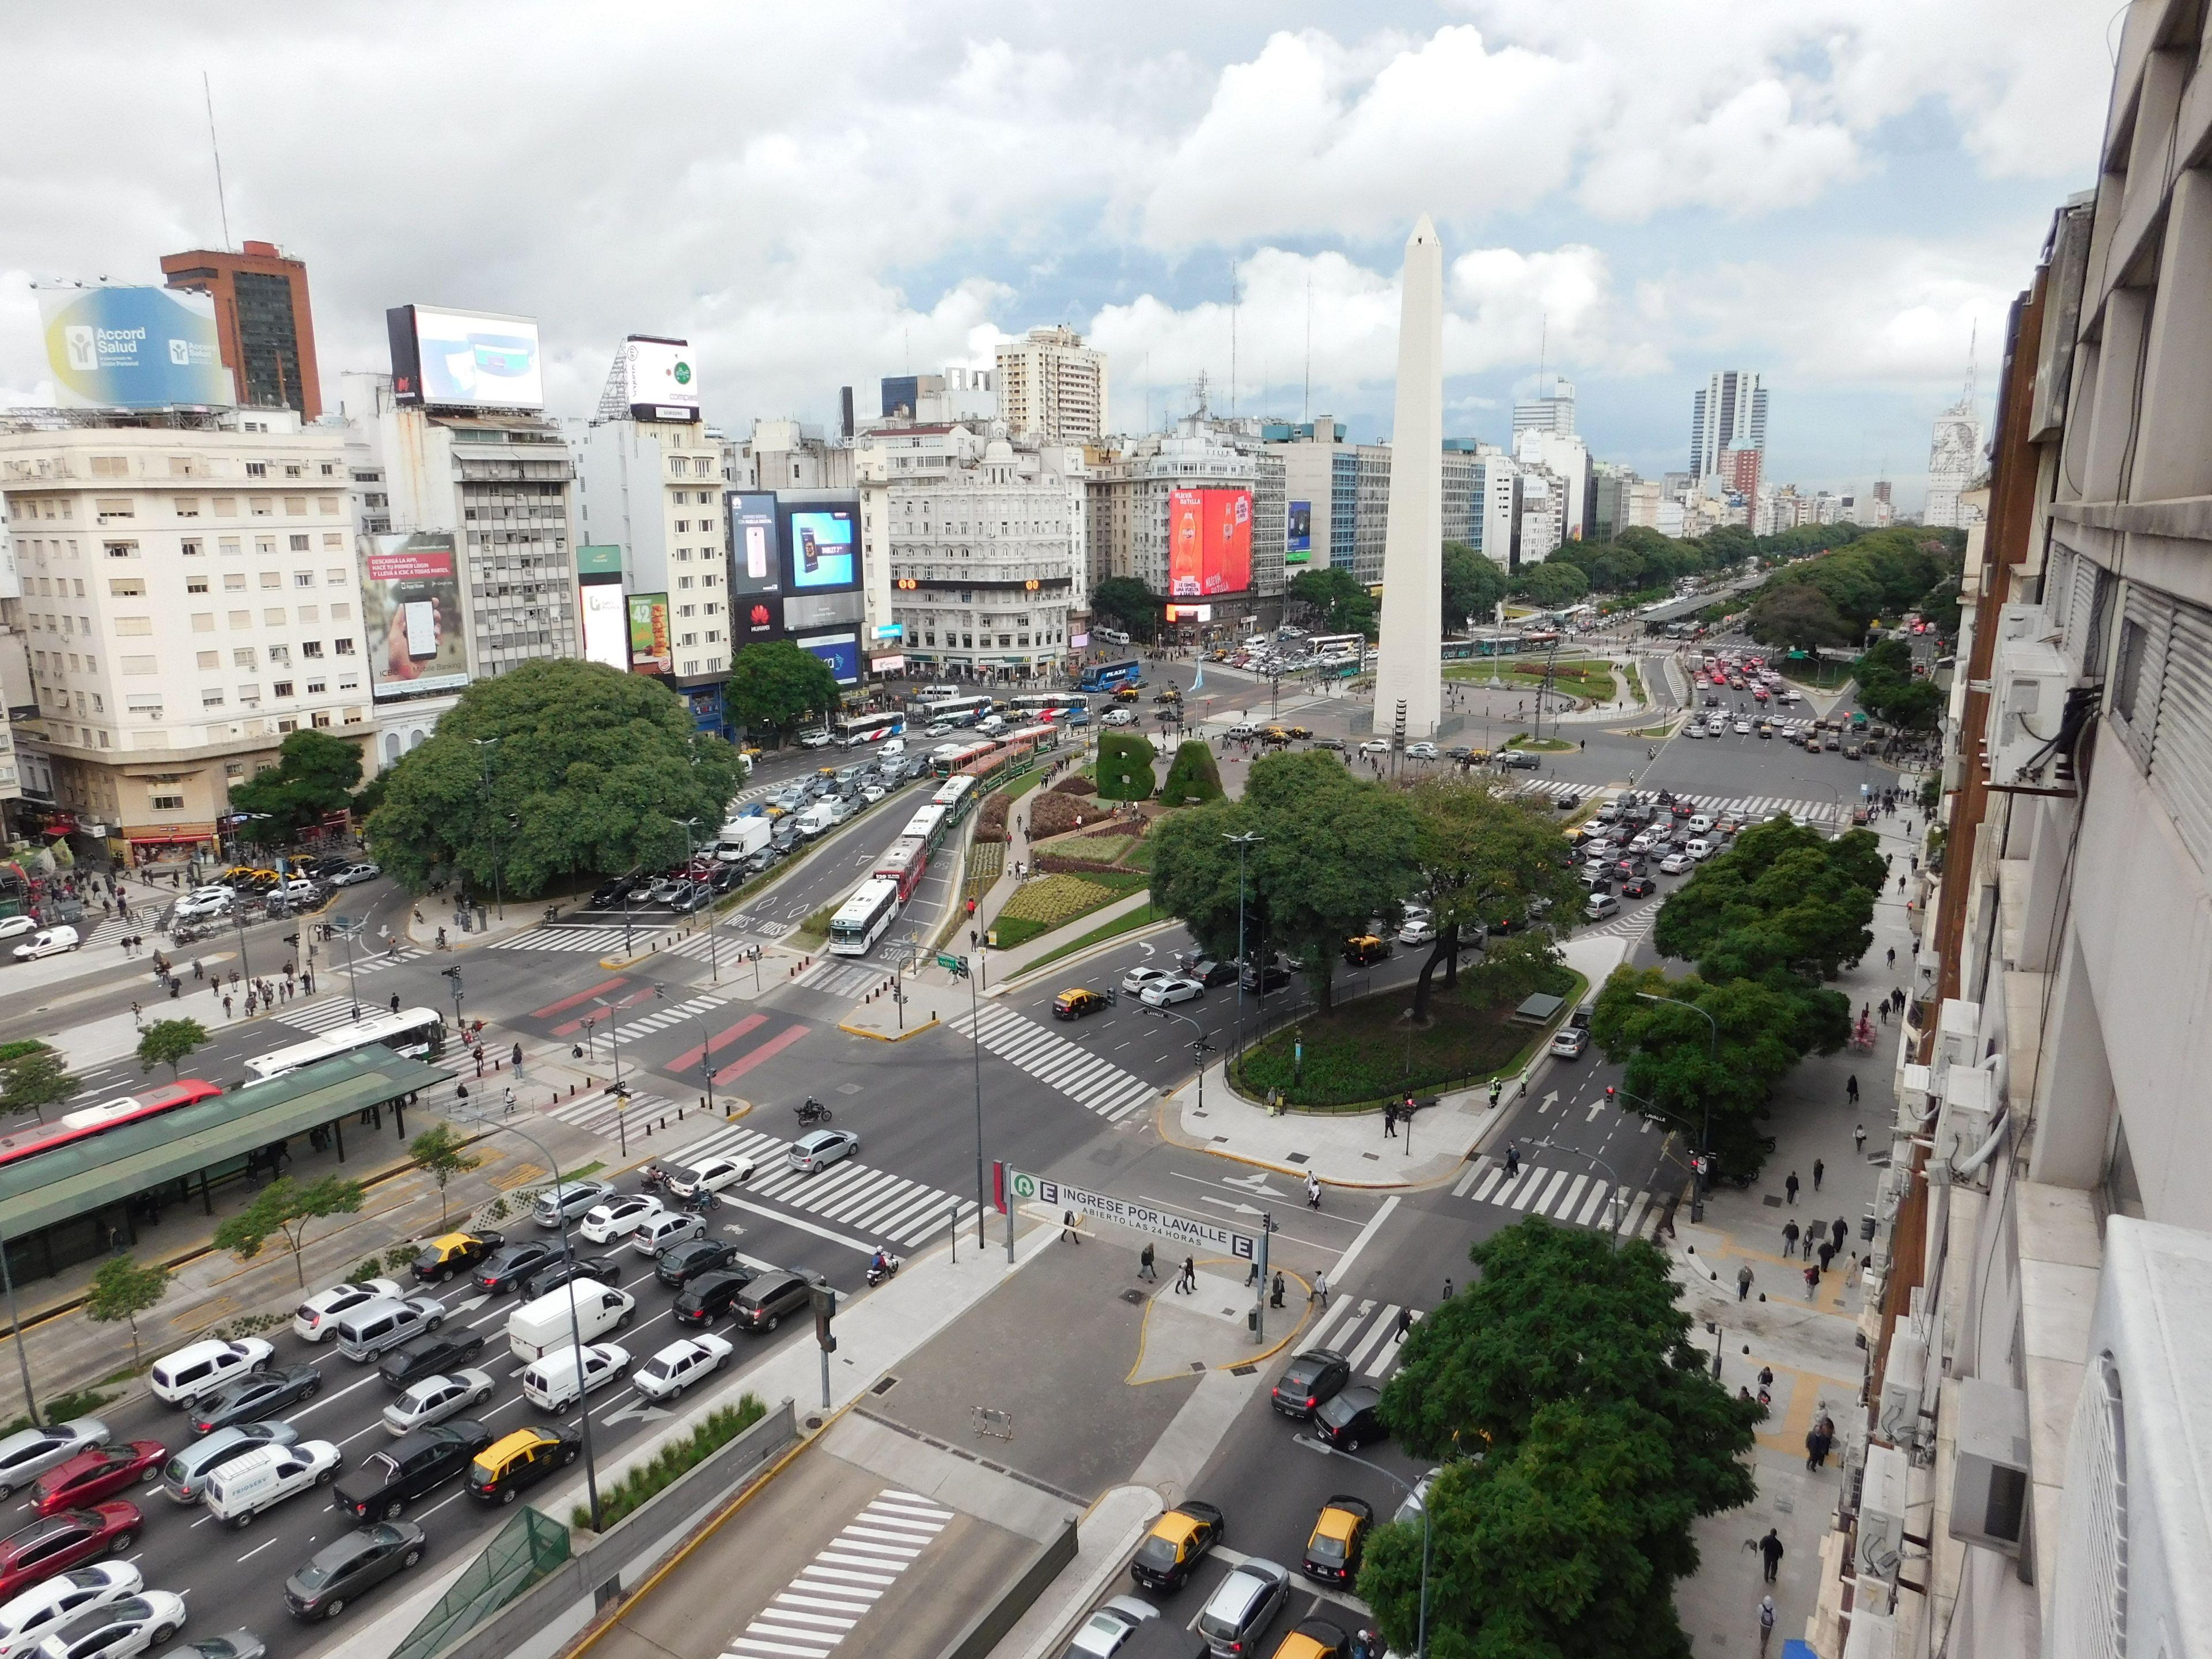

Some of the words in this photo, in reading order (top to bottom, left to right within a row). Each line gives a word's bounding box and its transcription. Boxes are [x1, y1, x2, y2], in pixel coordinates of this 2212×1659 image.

[97, 327, 146, 340] Accord
[97, 340, 137, 353] Salud
[1206, 572, 1221, 588] NUEVA
[1210, 581, 1229, 594] BOTELLA
[751, 624, 770, 632] HUAWEI
[380, 668, 399, 677] ICBC
[413, 665, 435, 673] Mobile
[436, 662, 461, 671] Banking
[1107, 669, 1126, 677] PLAZA
[725, 914, 756, 928] BUS
[756, 921, 787, 935] BUS
[879, 948, 910, 962] BUS
[1645, 1112, 1666, 1122] LAVALLE
[1063, 1188, 1123, 1214] INGRESE
[1128, 1206, 1158, 1224] POR
[1162, 1215, 1227, 1243] LAVALLE
[1082, 1207, 1126, 1224] ABIERTO
[1129, 1220, 1148, 1230] LAS
[1152, 1226, 1162, 1234] 24
[1166, 1230, 1202, 1246] HORAS
[232, 1477, 266, 1496] FRIOSERV
